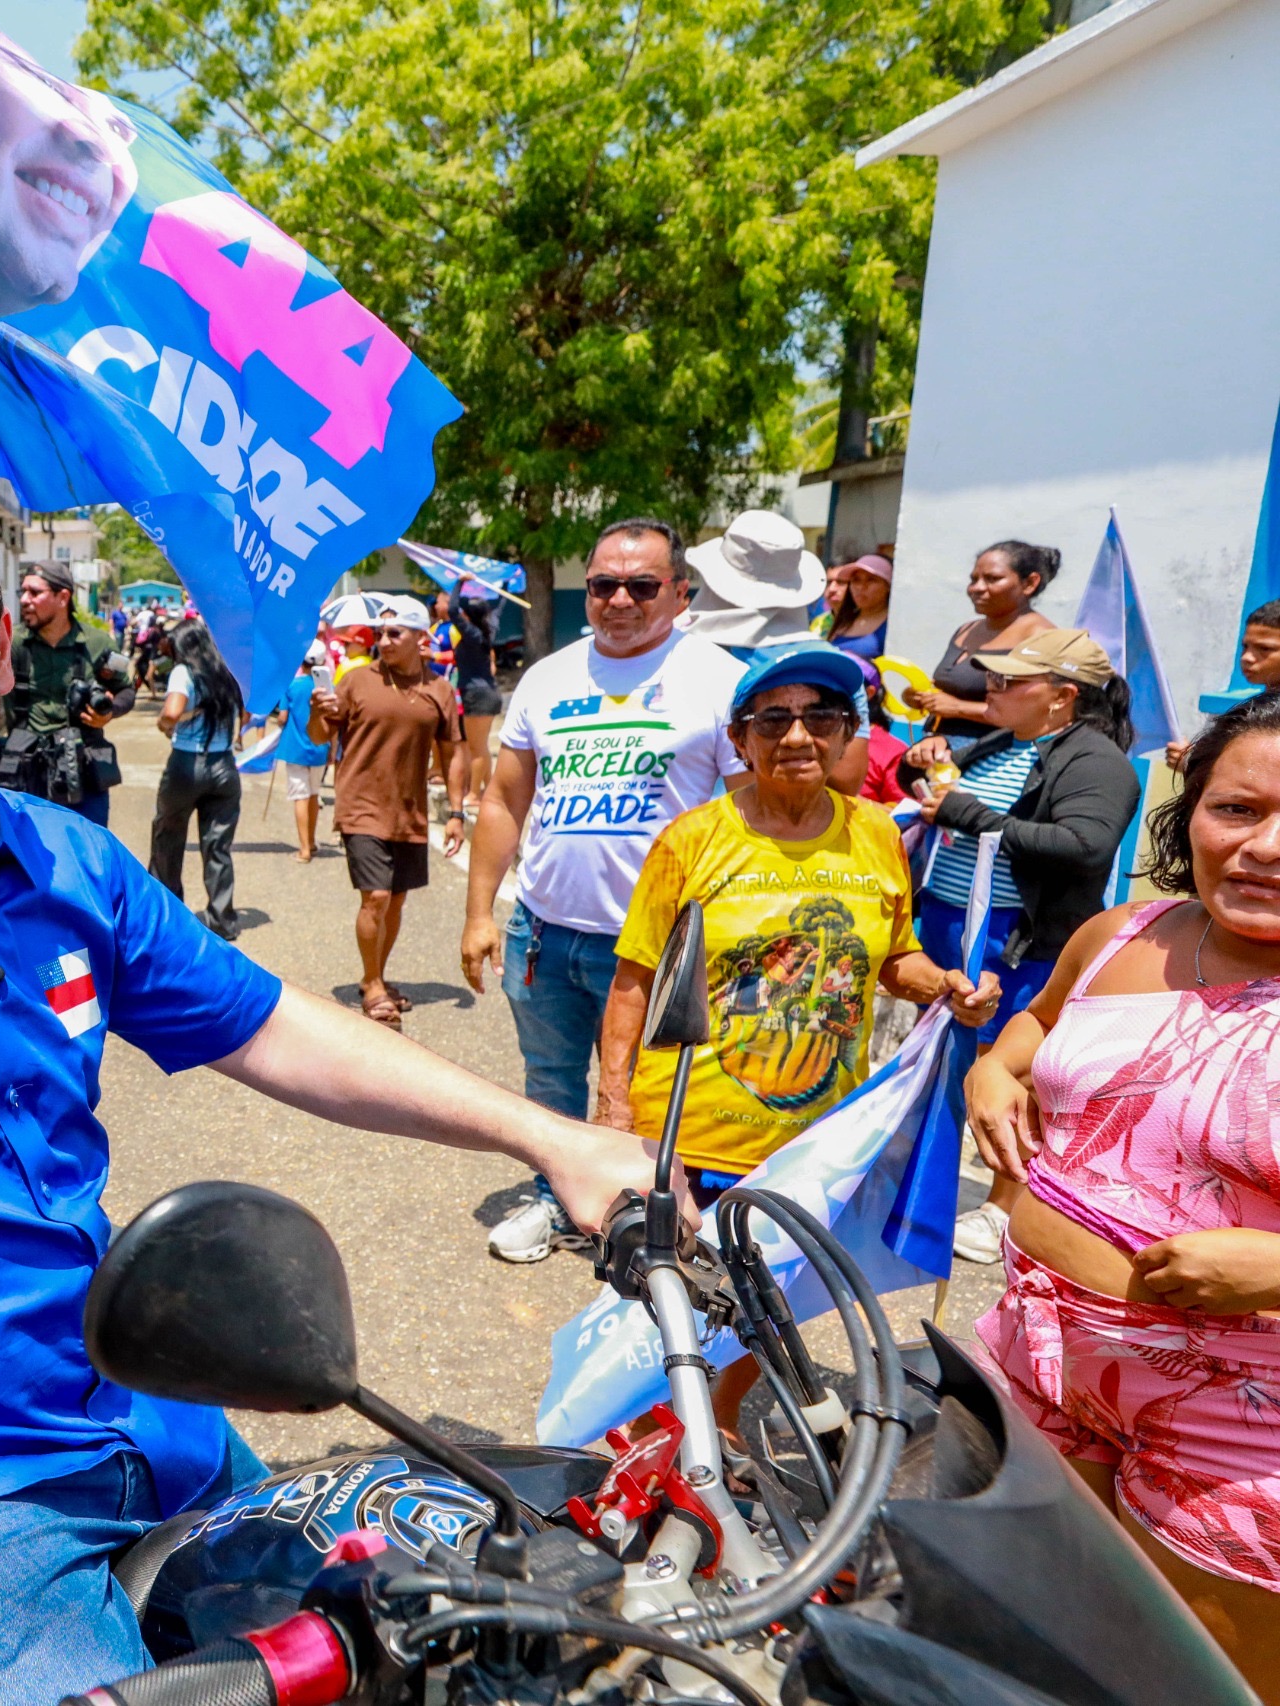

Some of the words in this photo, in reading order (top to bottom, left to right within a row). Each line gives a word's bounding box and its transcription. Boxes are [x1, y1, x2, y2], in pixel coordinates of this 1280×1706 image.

[565, 738, 587, 751] EU
[591, 737, 621, 750] SOU
[625, 735, 646, 748] DE
[540, 750, 676, 787] BARCELOS
[573, 781, 615, 792] FECHADO
[617, 780, 638, 791] COM
[639, 780, 648, 790] O
[540, 793, 664, 829] CIDADE
[812, 869, 881, 896] GUARD
[322, 1461, 375, 1518] HONDA
